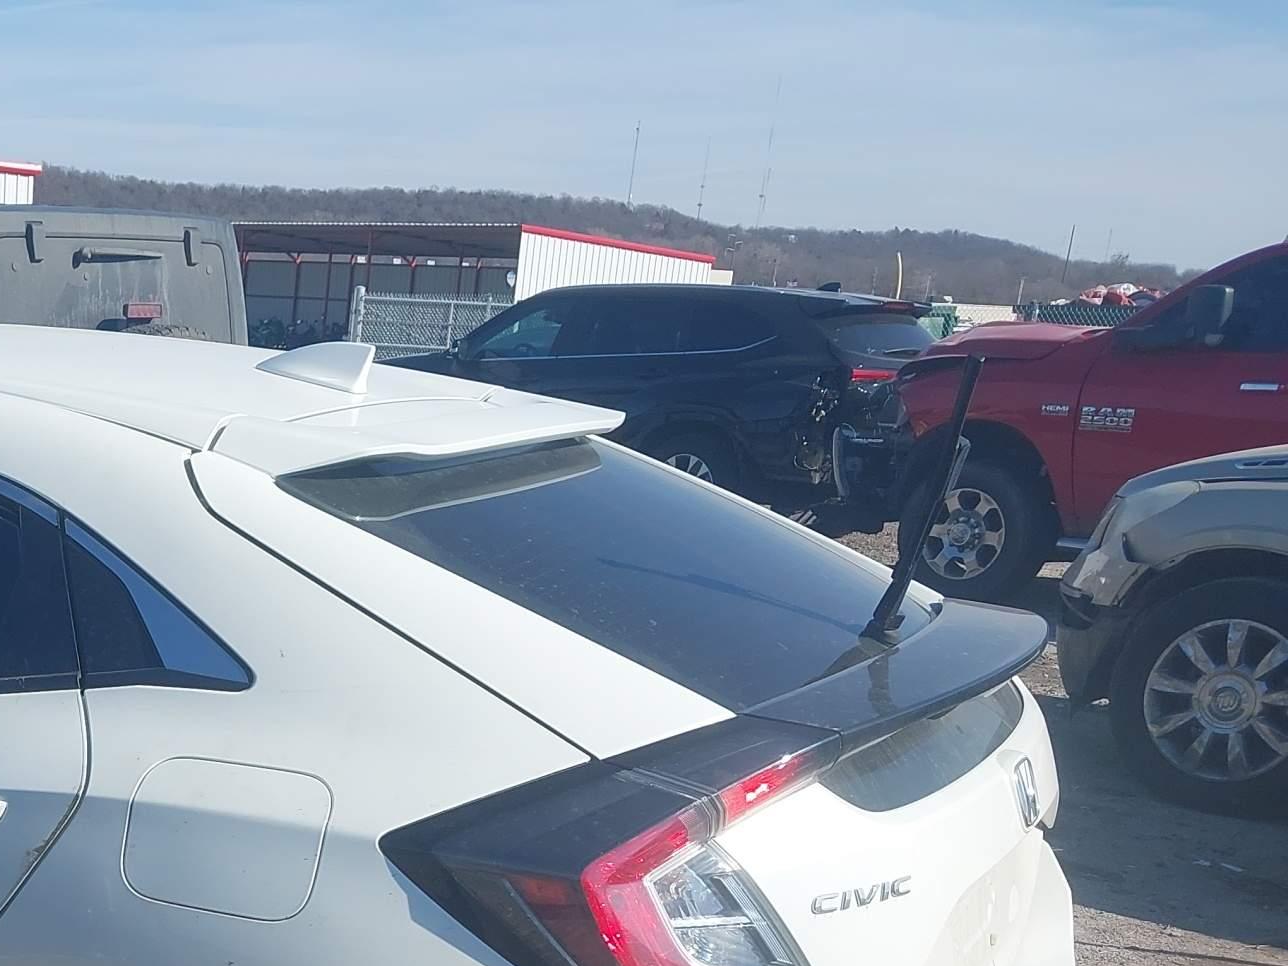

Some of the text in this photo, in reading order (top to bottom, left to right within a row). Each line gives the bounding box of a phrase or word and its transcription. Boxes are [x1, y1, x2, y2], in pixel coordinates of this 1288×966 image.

[1040, 404, 1069, 412] HEMI
[1081, 406, 1136, 417] RAM
[1079, 416, 1133, 426] 2500
[810, 875, 912, 915] CIVIC
